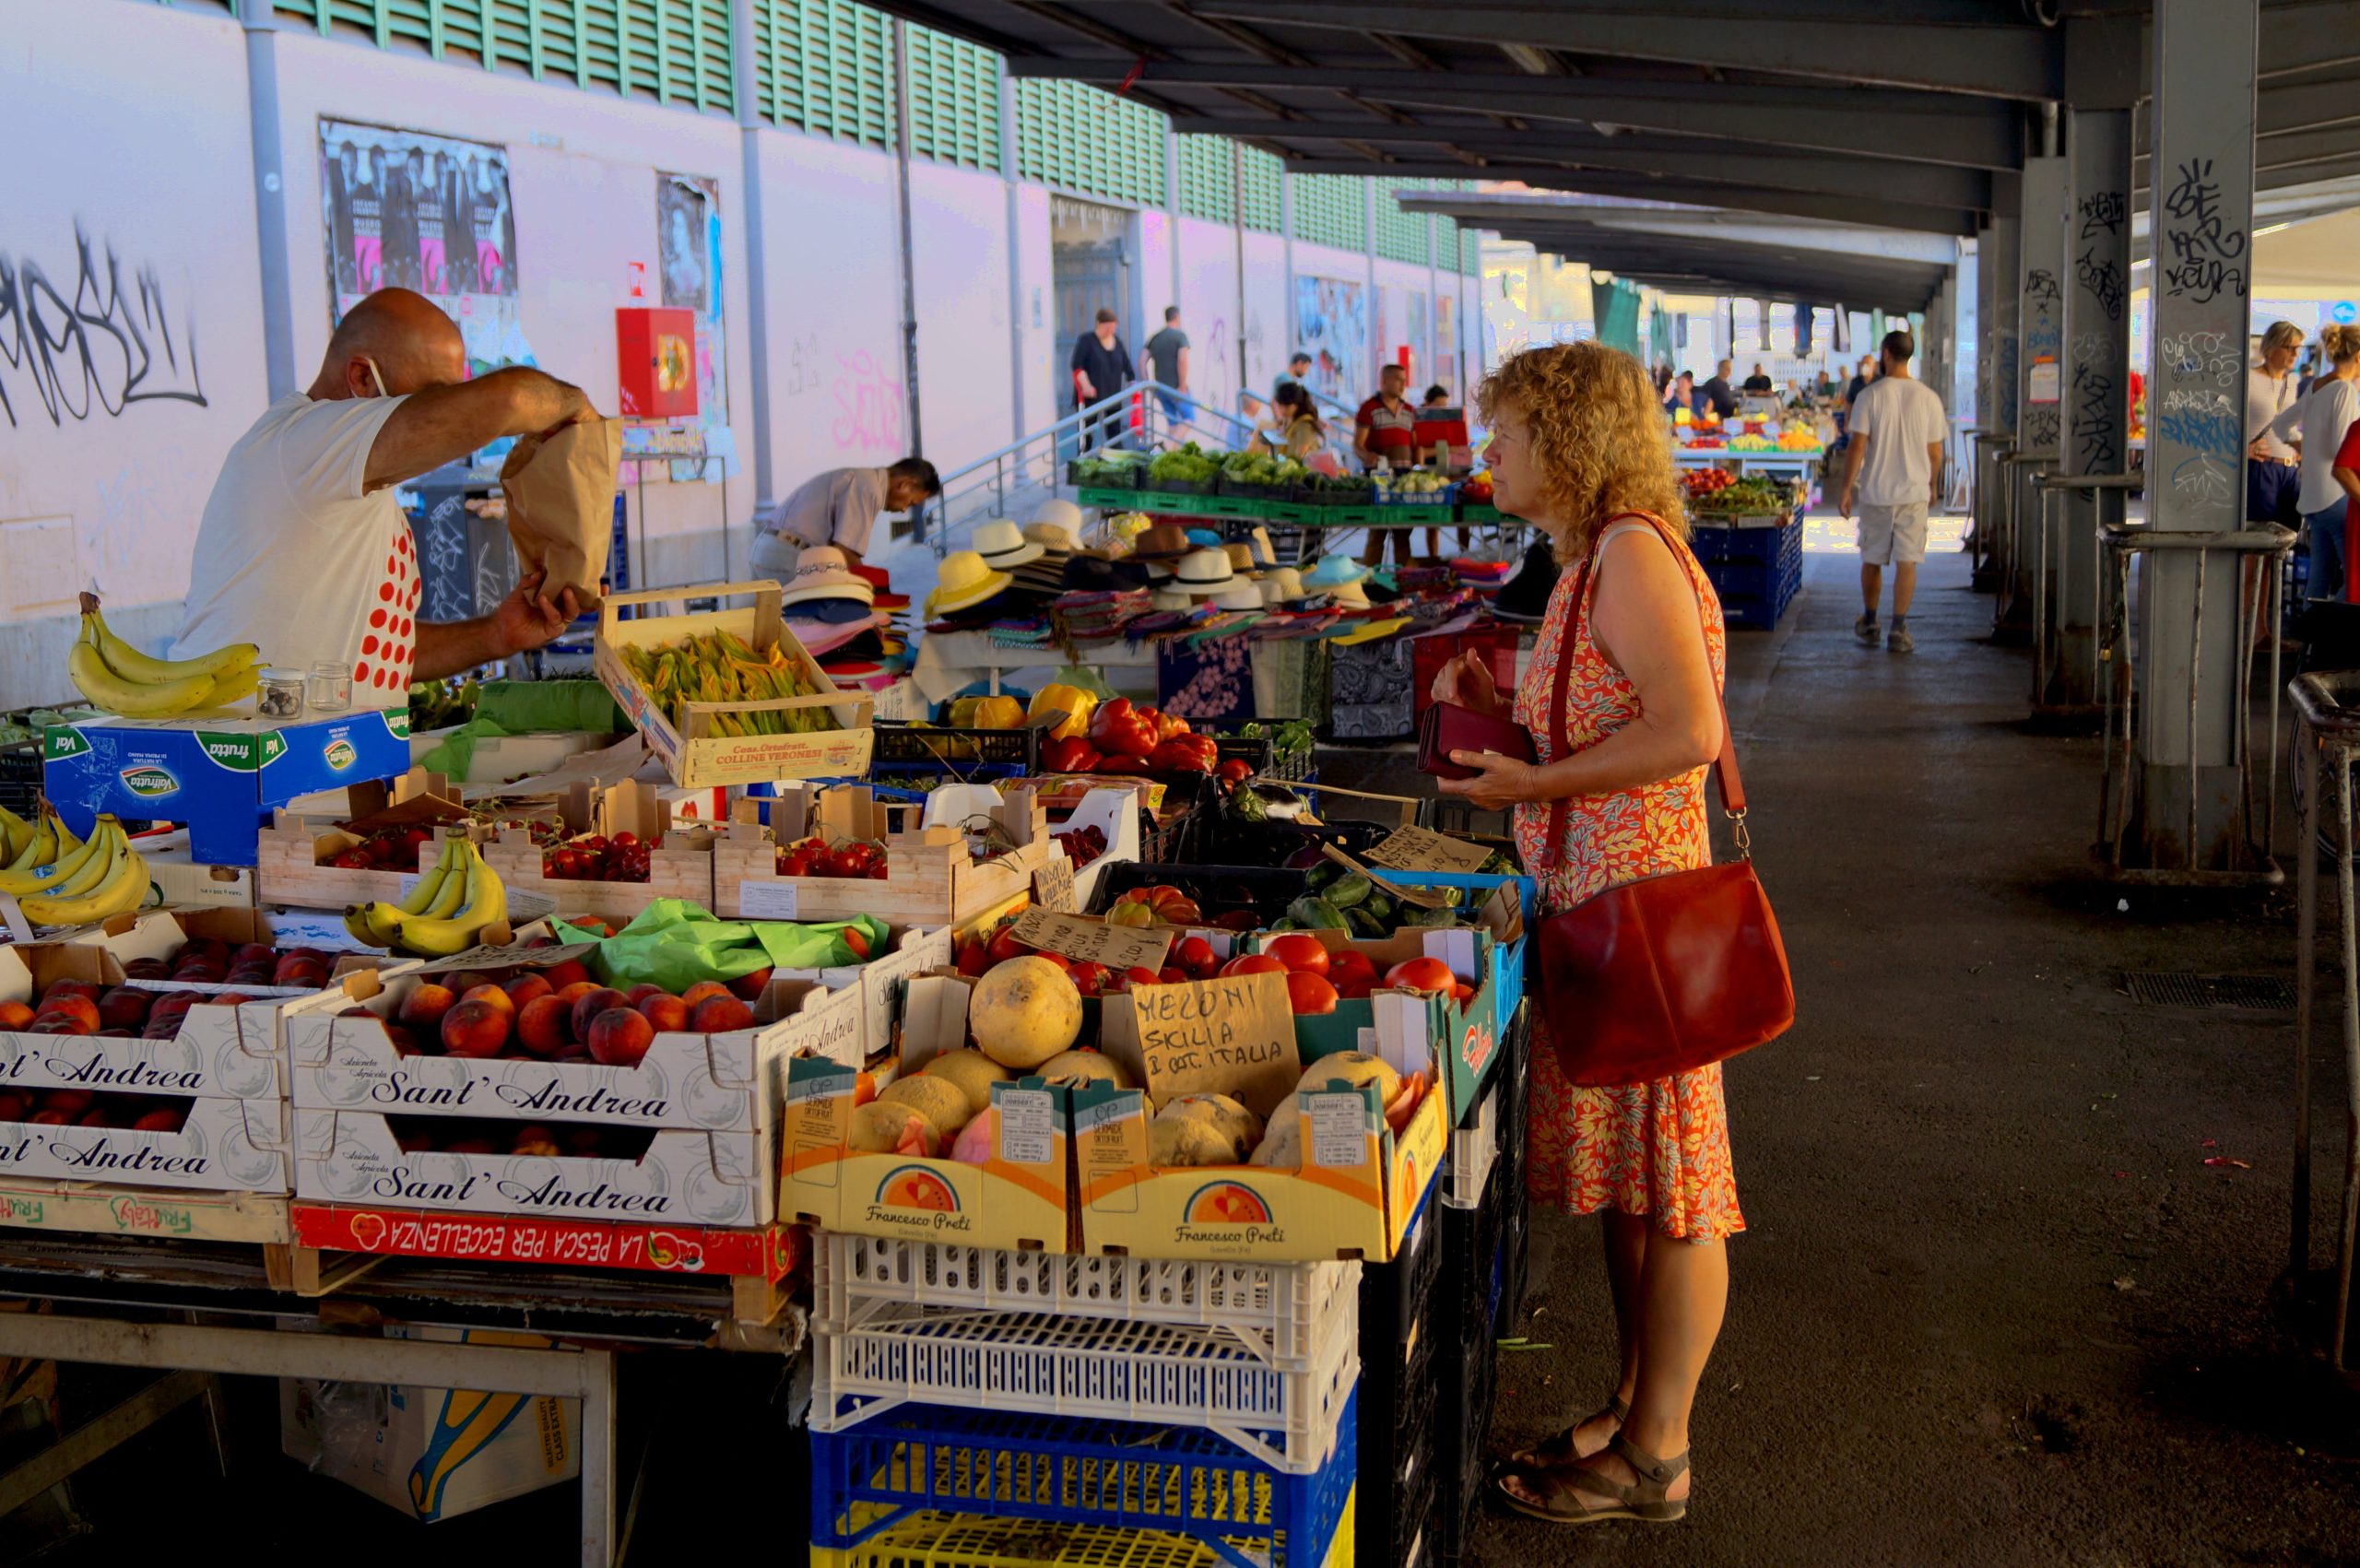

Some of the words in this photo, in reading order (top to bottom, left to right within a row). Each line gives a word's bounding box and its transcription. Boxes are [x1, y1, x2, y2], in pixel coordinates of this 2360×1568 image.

[56, 737, 76, 751] Val
[210, 743, 249, 759] frutta
[716, 751, 766, 765] COLLINE
[768, 749, 822, 761] VERONESI
[130, 777, 172, 790] Valfrutta
[1137, 984, 1256, 1022] MELONI
[809, 1016, 856, 1053] Andrea
[1208, 1041, 1282, 1067] ITALIA
[44, 1052, 207, 1090] Andrea
[371, 1070, 490, 1106] Sant'
[495, 1078, 672, 1118] Andrea
[49, 1138, 212, 1174] Andrea
[372, 1166, 491, 1199] Sant'
[496, 1174, 674, 1214] Andrea
[866, 1206, 930, 1229] Francesco
[933, 1210, 971, 1232] Preti
[1174, 1225, 1243, 1244] Francesco
[1245, 1226, 1285, 1244] Preti
[390, 1221, 506, 1256] ECCELLENZA
[512, 1228, 547, 1257] PER
[554, 1230, 613, 1262] PESCA
[619, 1234, 643, 1265] LA
[539, 1400, 550, 1432] QUALITY
[553, 1431, 564, 1461] CLASS
